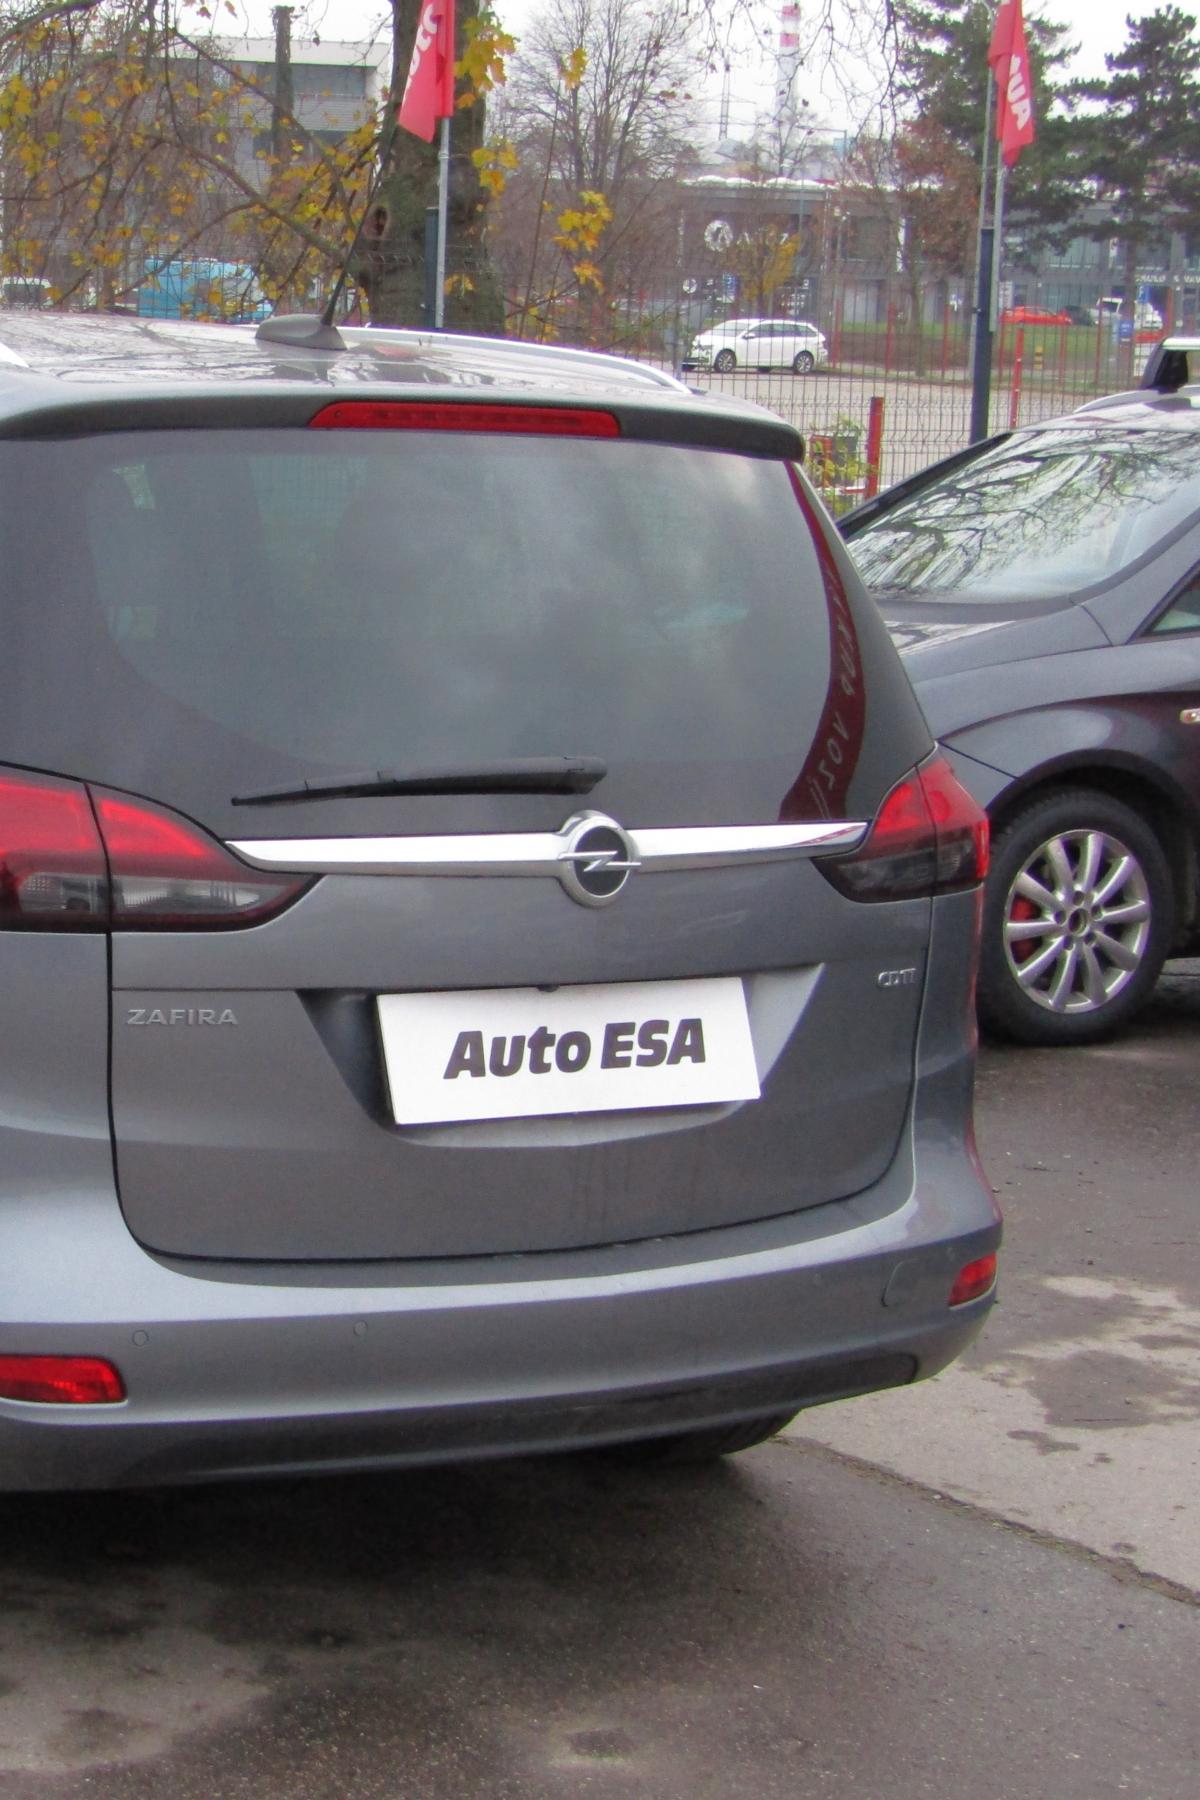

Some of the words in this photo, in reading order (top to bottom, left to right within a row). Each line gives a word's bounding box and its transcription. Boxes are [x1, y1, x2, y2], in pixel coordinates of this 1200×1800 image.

[127, 1008, 240, 1025] ZAFIRA
[443, 1026, 592, 1080] Auto
[600, 1018, 706, 1069] ESA
